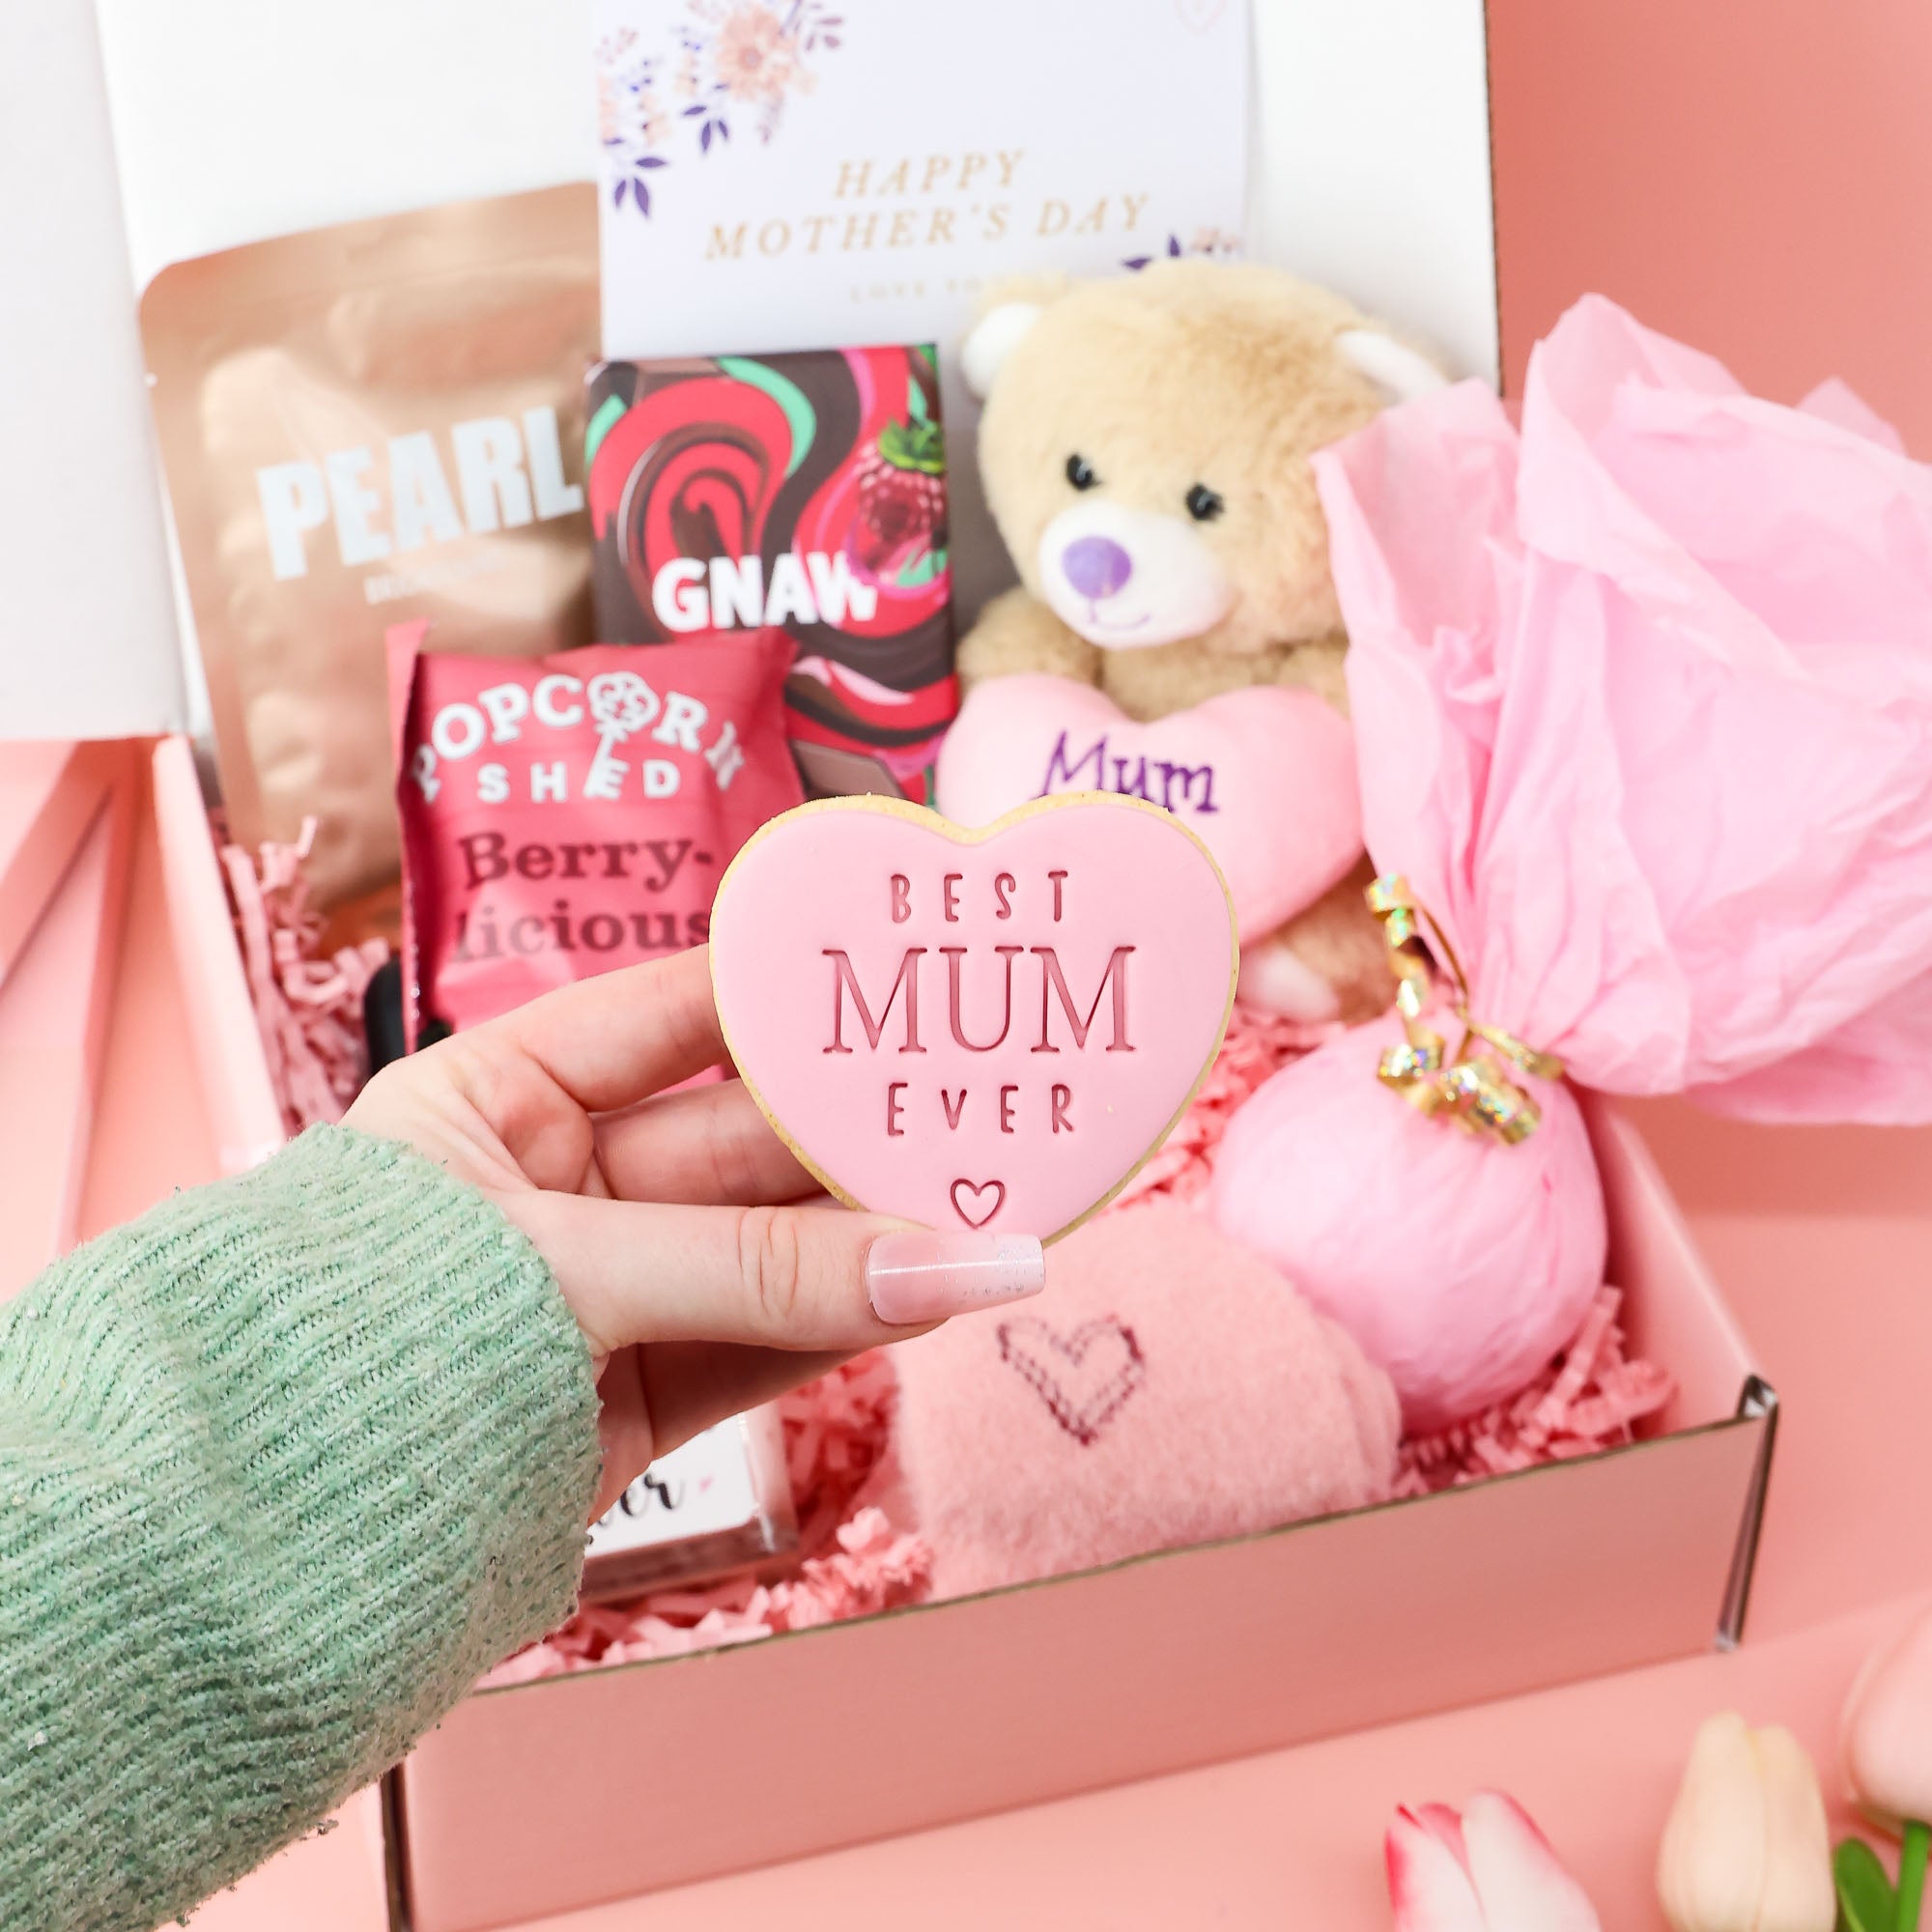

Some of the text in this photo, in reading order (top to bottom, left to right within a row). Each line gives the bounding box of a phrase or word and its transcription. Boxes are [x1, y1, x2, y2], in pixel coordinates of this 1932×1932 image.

[833, 150, 1027, 201] HAPPY
[704, 194, 1151, 261] MOTHER'S DAY
[256, 406, 583, 582] PEARL
[652, 552, 878, 633] GNAW
[412, 670, 746, 805] POPCORN
[477, 757, 681, 803] SHED
[1029, 730, 1220, 814] Mum
[459, 830, 714, 894] Berry-
[890, 870, 1068, 923] BEST
[822, 946, 1136, 1053] MUM
[887, 1082, 1074, 1137] EVER
